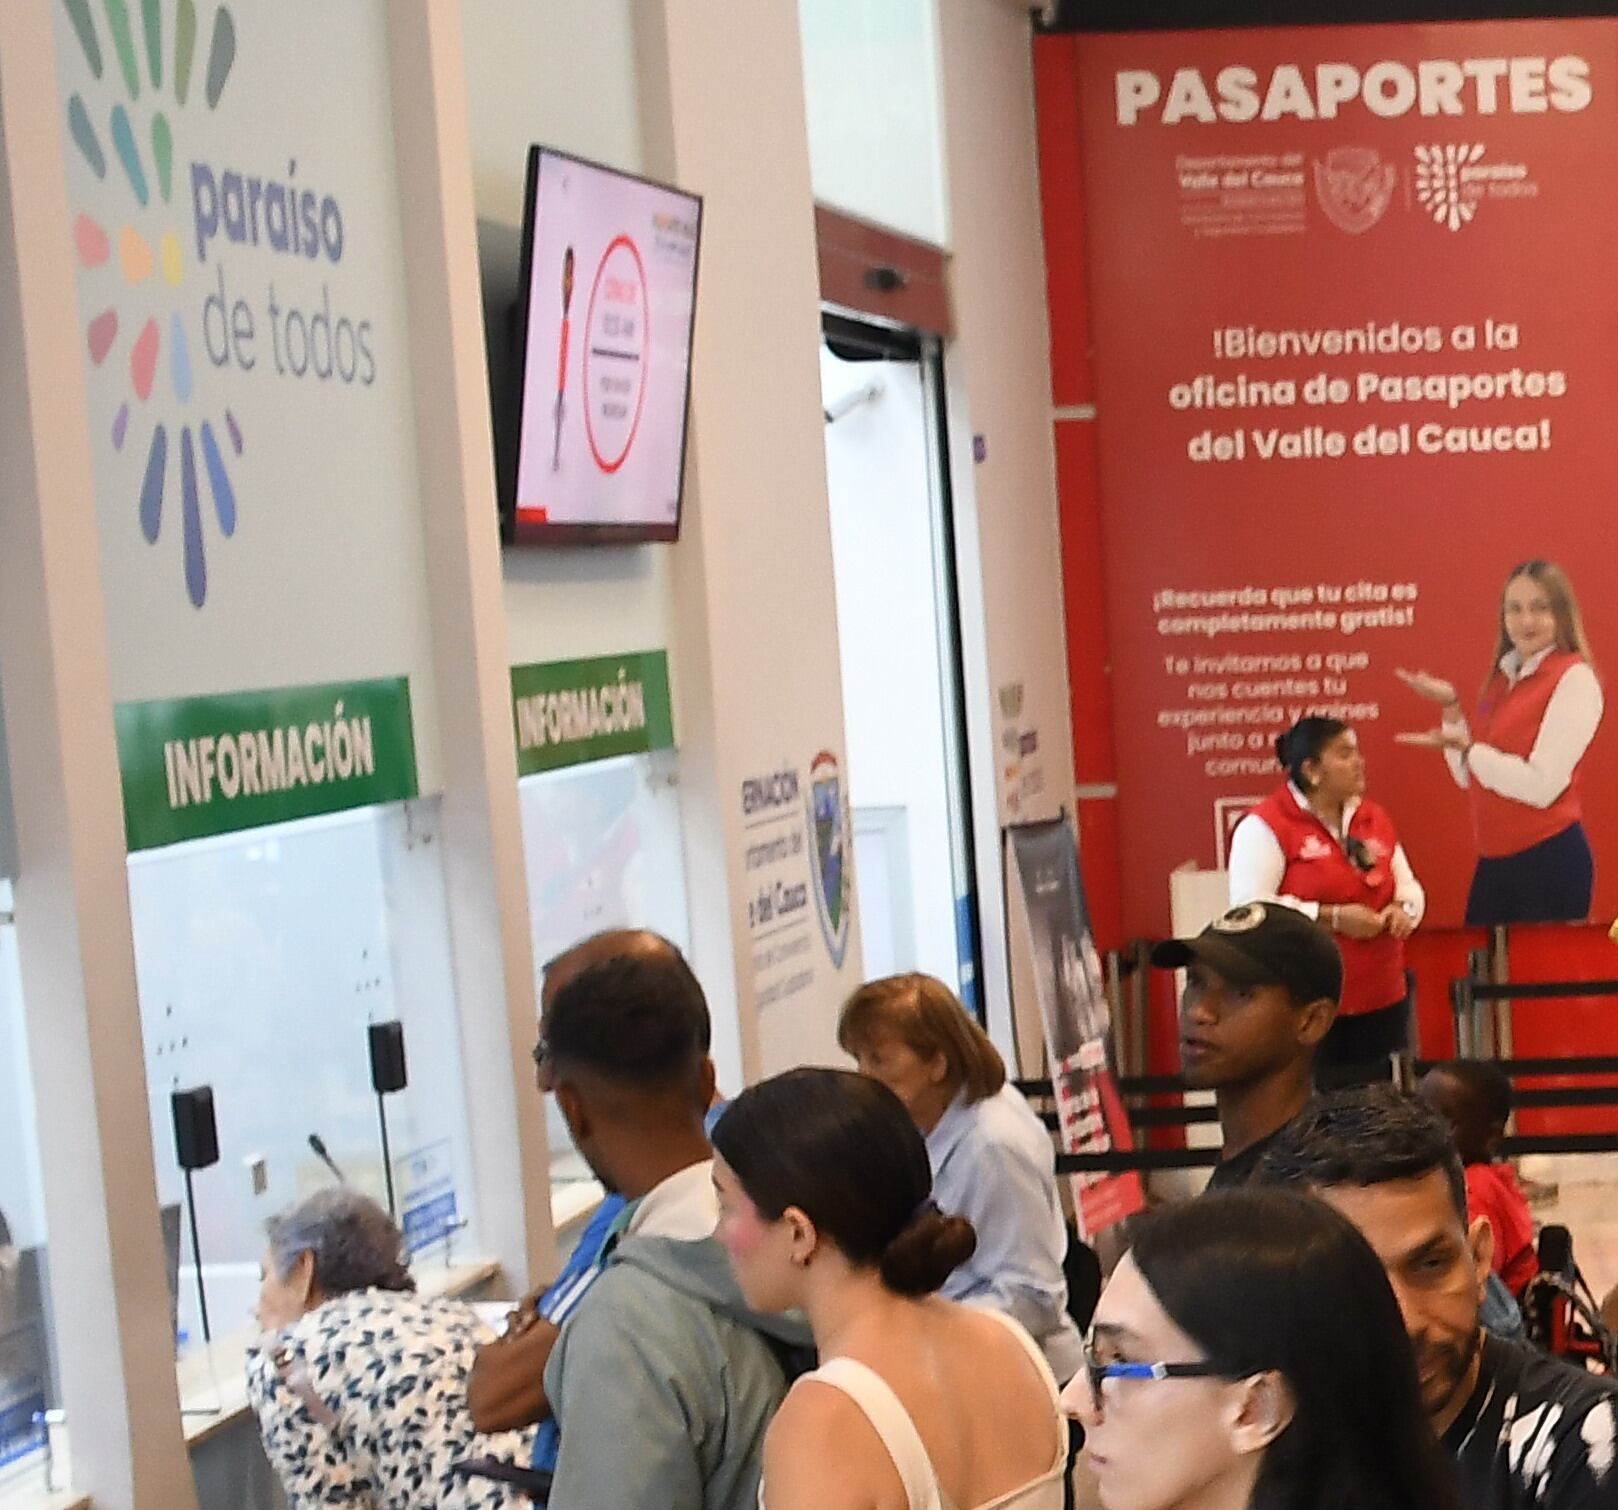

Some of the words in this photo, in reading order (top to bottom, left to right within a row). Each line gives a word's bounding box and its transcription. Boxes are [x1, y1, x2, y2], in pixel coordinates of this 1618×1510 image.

[1115, 56, 1592, 126] PASAPORTES
[191, 158, 343, 263] paraíso
[203, 262, 255, 371] de
[268, 282, 376, 386] todos
[1451, 324, 1476, 352] a
[1485, 317, 1519, 351] la
[1168, 373, 1297, 410] oficina
[1303, 371, 1351, 405] de
[1356, 368, 1568, 409] Pasaportes
[1187, 429, 1246, 462] del
[1252, 426, 1347, 459] Valle
[1353, 422, 1410, 456] del
[1417, 418, 1552, 454] Cauca!
[1270, 587, 1314, 609] que
[1317, 582, 1343, 604] tu
[1344, 579, 1389, 603] cita
[1391, 582, 1418, 601] es
[1157, 609, 1337, 638] completamente
[1340, 604, 1415, 636] gratis!
[1164, 656, 1190, 676] Te
[1194, 653, 1302, 675] invitamos
[1305, 653, 1322, 672] a
[1326, 651, 1370, 674] que
[1187, 681, 1229, 700] nos
[1231, 677, 1321, 699] cuentes
[1322, 676, 1348, 696] tu
[517, 665, 646, 750] INFORMACIÓN
[1156, 704, 1285, 729] experiencia
[164, 699, 376, 810] INFORMACIÓN
[1186, 730, 1245, 757] junto
[1247, 732, 1264, 749] a
